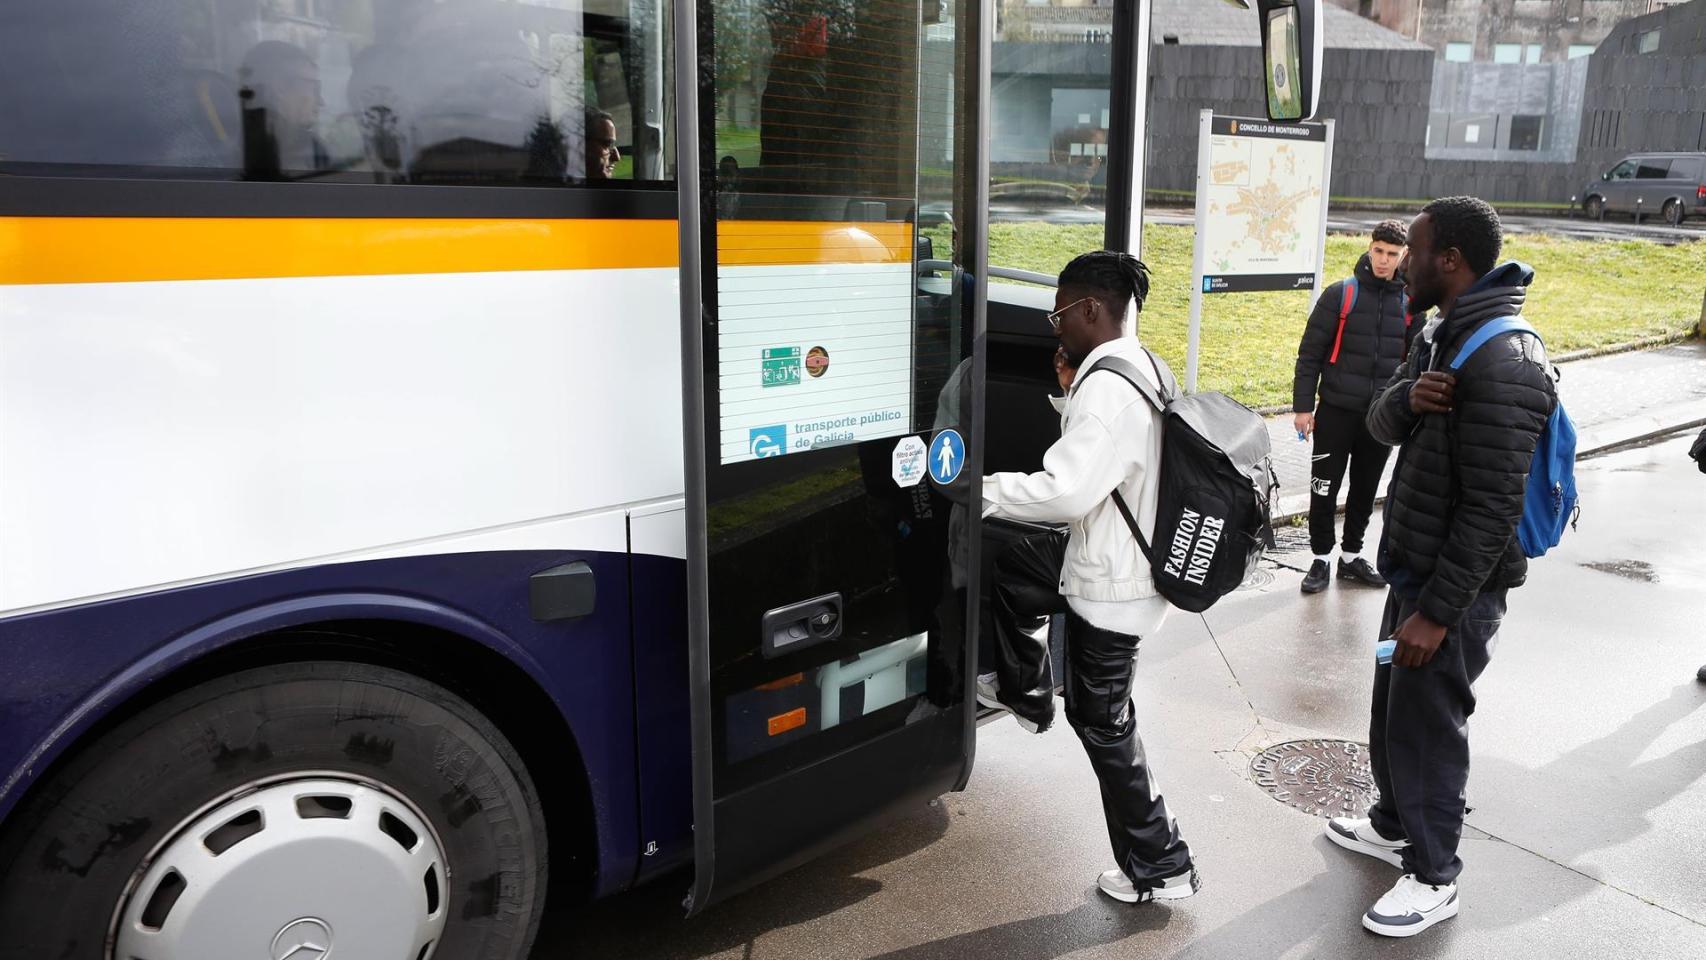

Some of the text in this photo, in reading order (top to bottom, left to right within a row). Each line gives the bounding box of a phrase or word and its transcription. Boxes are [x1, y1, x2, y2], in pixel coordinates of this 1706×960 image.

[1239, 123, 1268, 133] CONCELLO
[1276, 126, 1310, 136] MONTERROSO
[795, 410, 901, 434] transporte público
[795, 431, 854, 448] de Galicia
[1311, 477, 1331, 496] KE
[1164, 507, 1200, 579] FASHION
[1184, 516, 1225, 586] INSIDER
